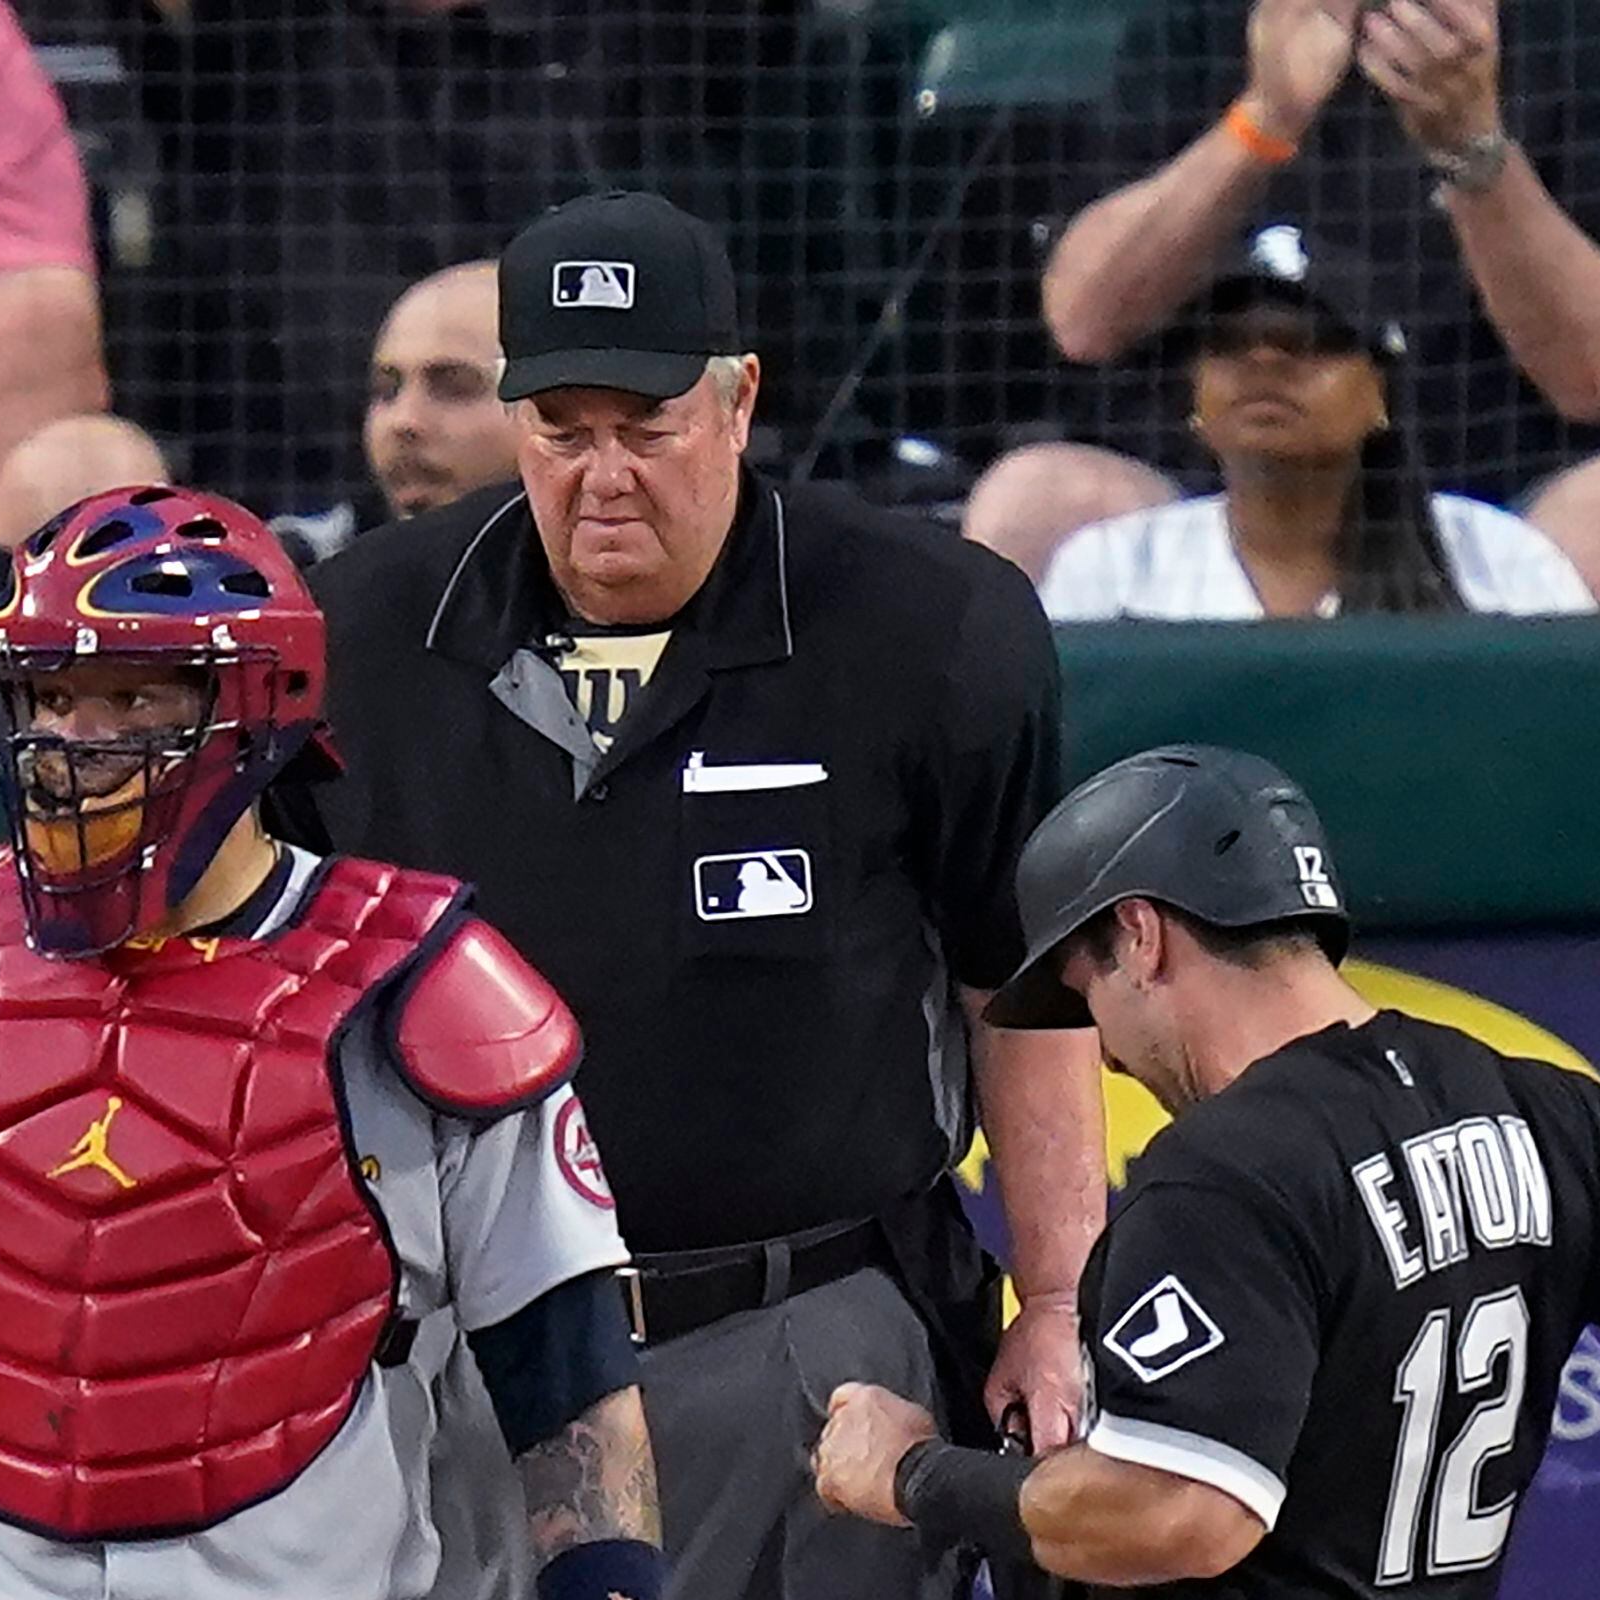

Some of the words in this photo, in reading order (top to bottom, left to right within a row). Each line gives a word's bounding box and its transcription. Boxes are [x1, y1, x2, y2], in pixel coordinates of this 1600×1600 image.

[1293, 846, 1328, 882] 12
[1351, 1114, 1553, 1291] EATON
[1375, 1284, 1531, 1587] 12
